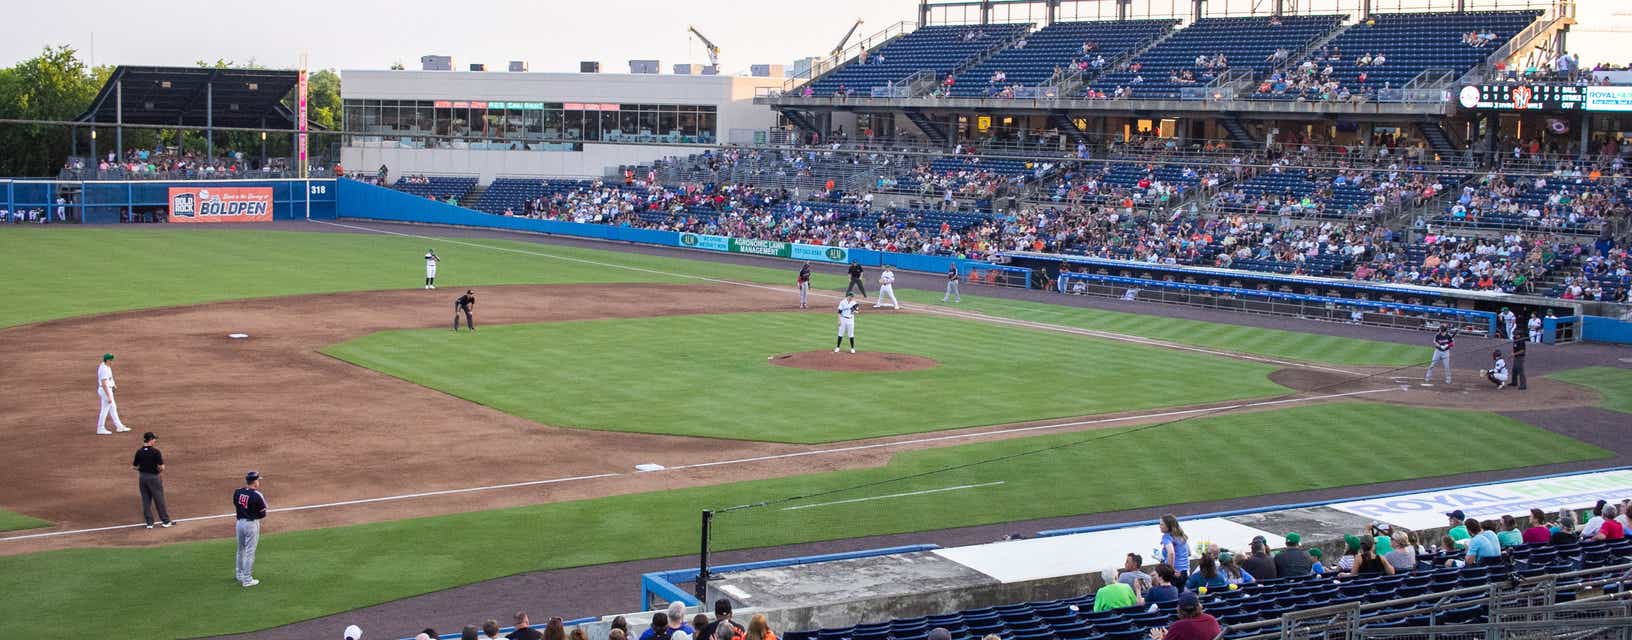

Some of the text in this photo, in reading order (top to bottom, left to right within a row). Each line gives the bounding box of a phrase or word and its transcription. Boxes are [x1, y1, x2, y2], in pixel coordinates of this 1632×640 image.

[311, 186, 326, 194] 318
[200, 200, 267, 216] BOLDPEN
[734, 238, 768, 248] AGRONOMIC
[768, 241, 785, 250] LAWN
[740, 246, 778, 255] MANAGEMENT
[238, 494, 250, 508] 4
[1350, 490, 1520, 516] ROYAL
